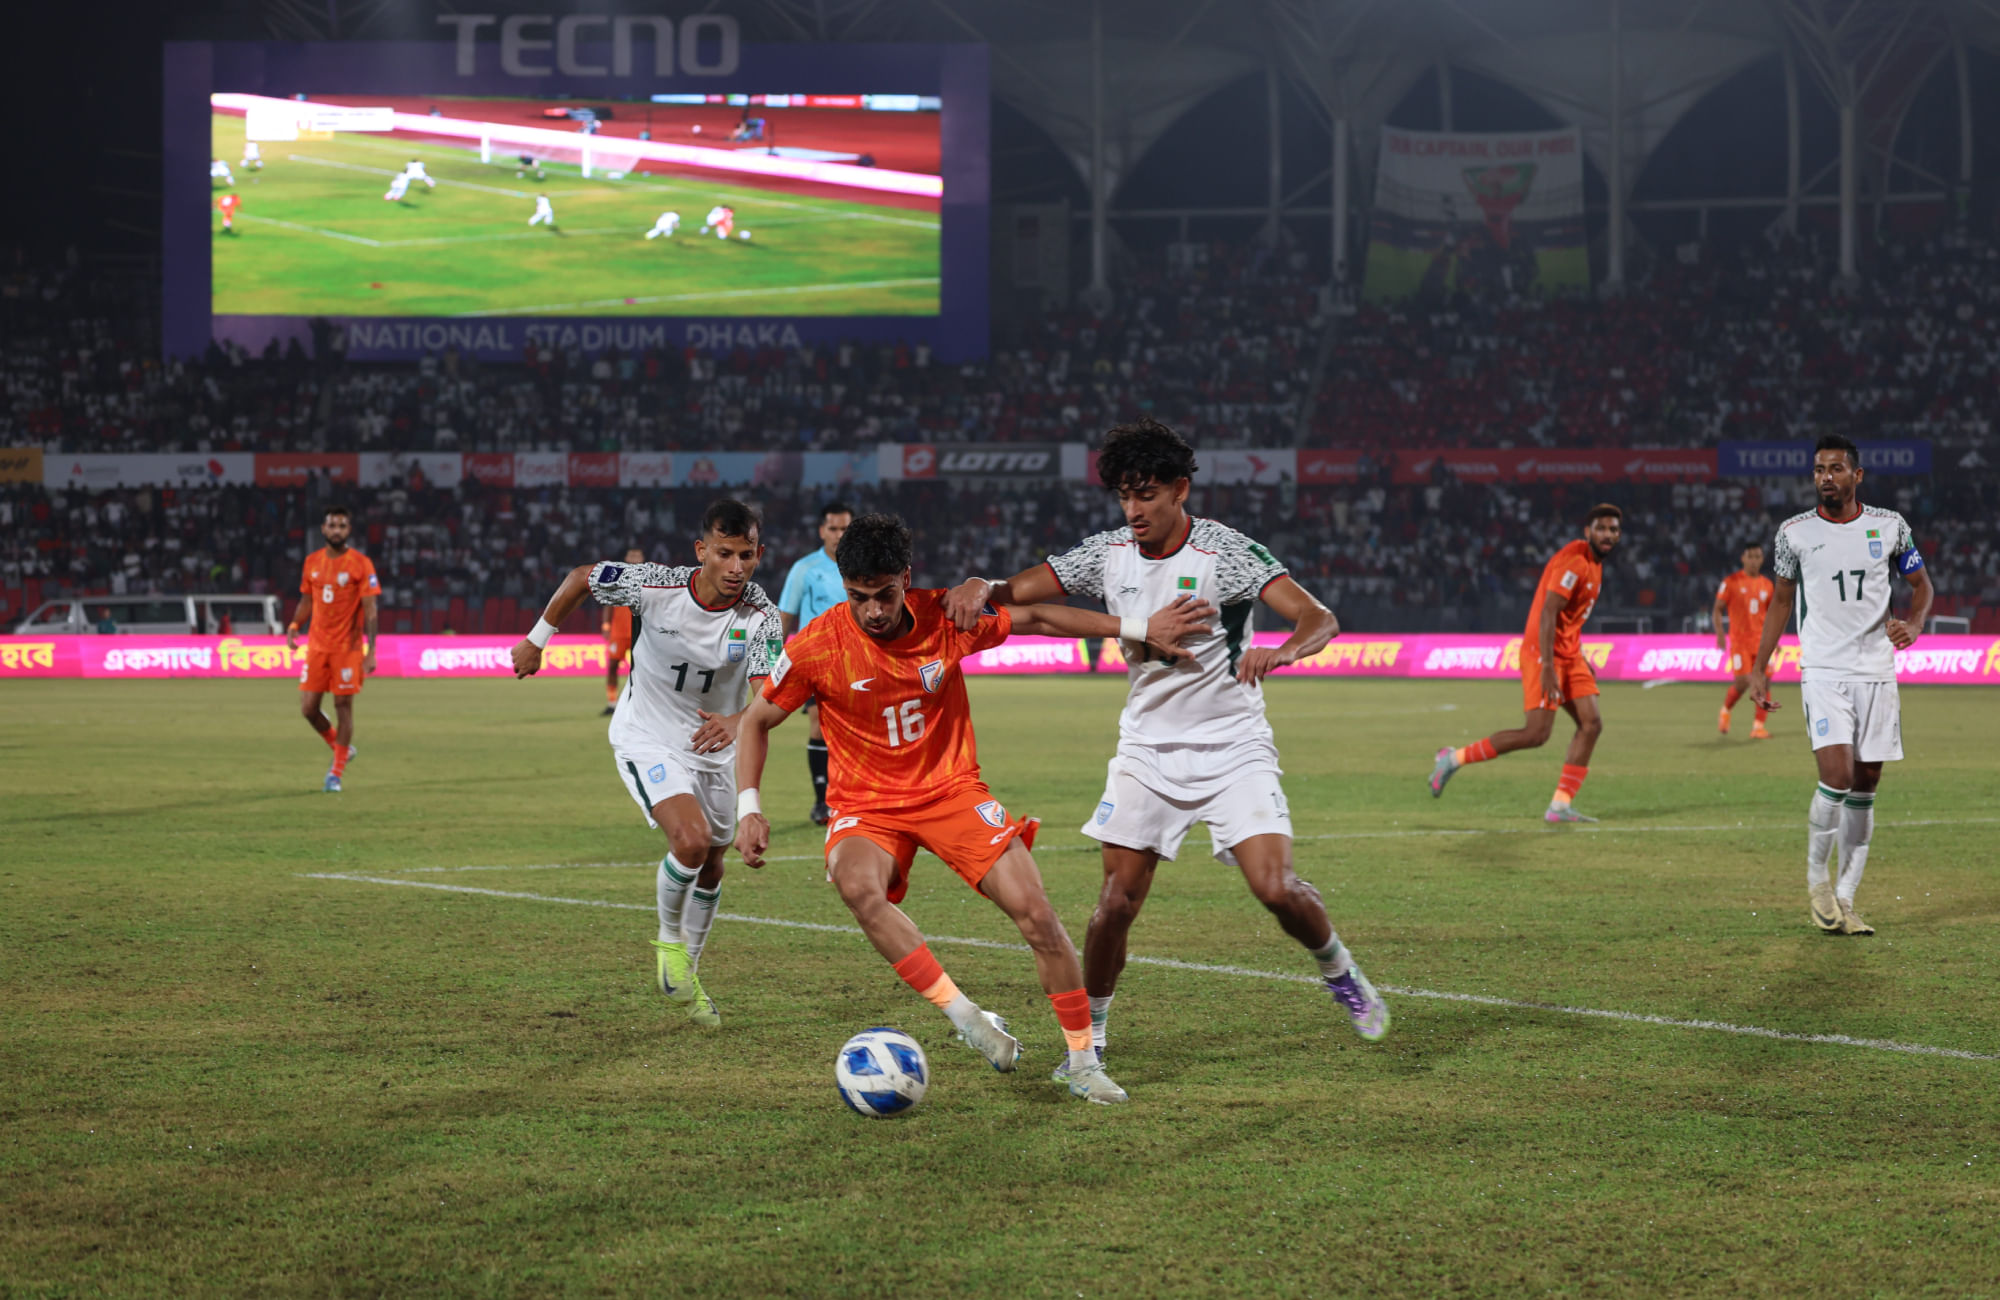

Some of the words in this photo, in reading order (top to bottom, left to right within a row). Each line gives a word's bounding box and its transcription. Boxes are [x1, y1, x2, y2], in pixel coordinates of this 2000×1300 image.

[436, 14, 740, 77] TECNO
[349, 323, 512, 350] NATIONAL
[525, 323, 664, 349] STADIUM
[685, 323, 801, 349] DHAKA
[939, 451, 1050, 472] LOTTO
[1736, 448, 1806, 468] TECNO
[1857, 448, 1914, 468] ECNO
[323, 584, 334, 604] 6
[1832, 569, 1866, 602] 17
[670, 662, 715, 694] 11
[882, 698, 926, 748] 16
